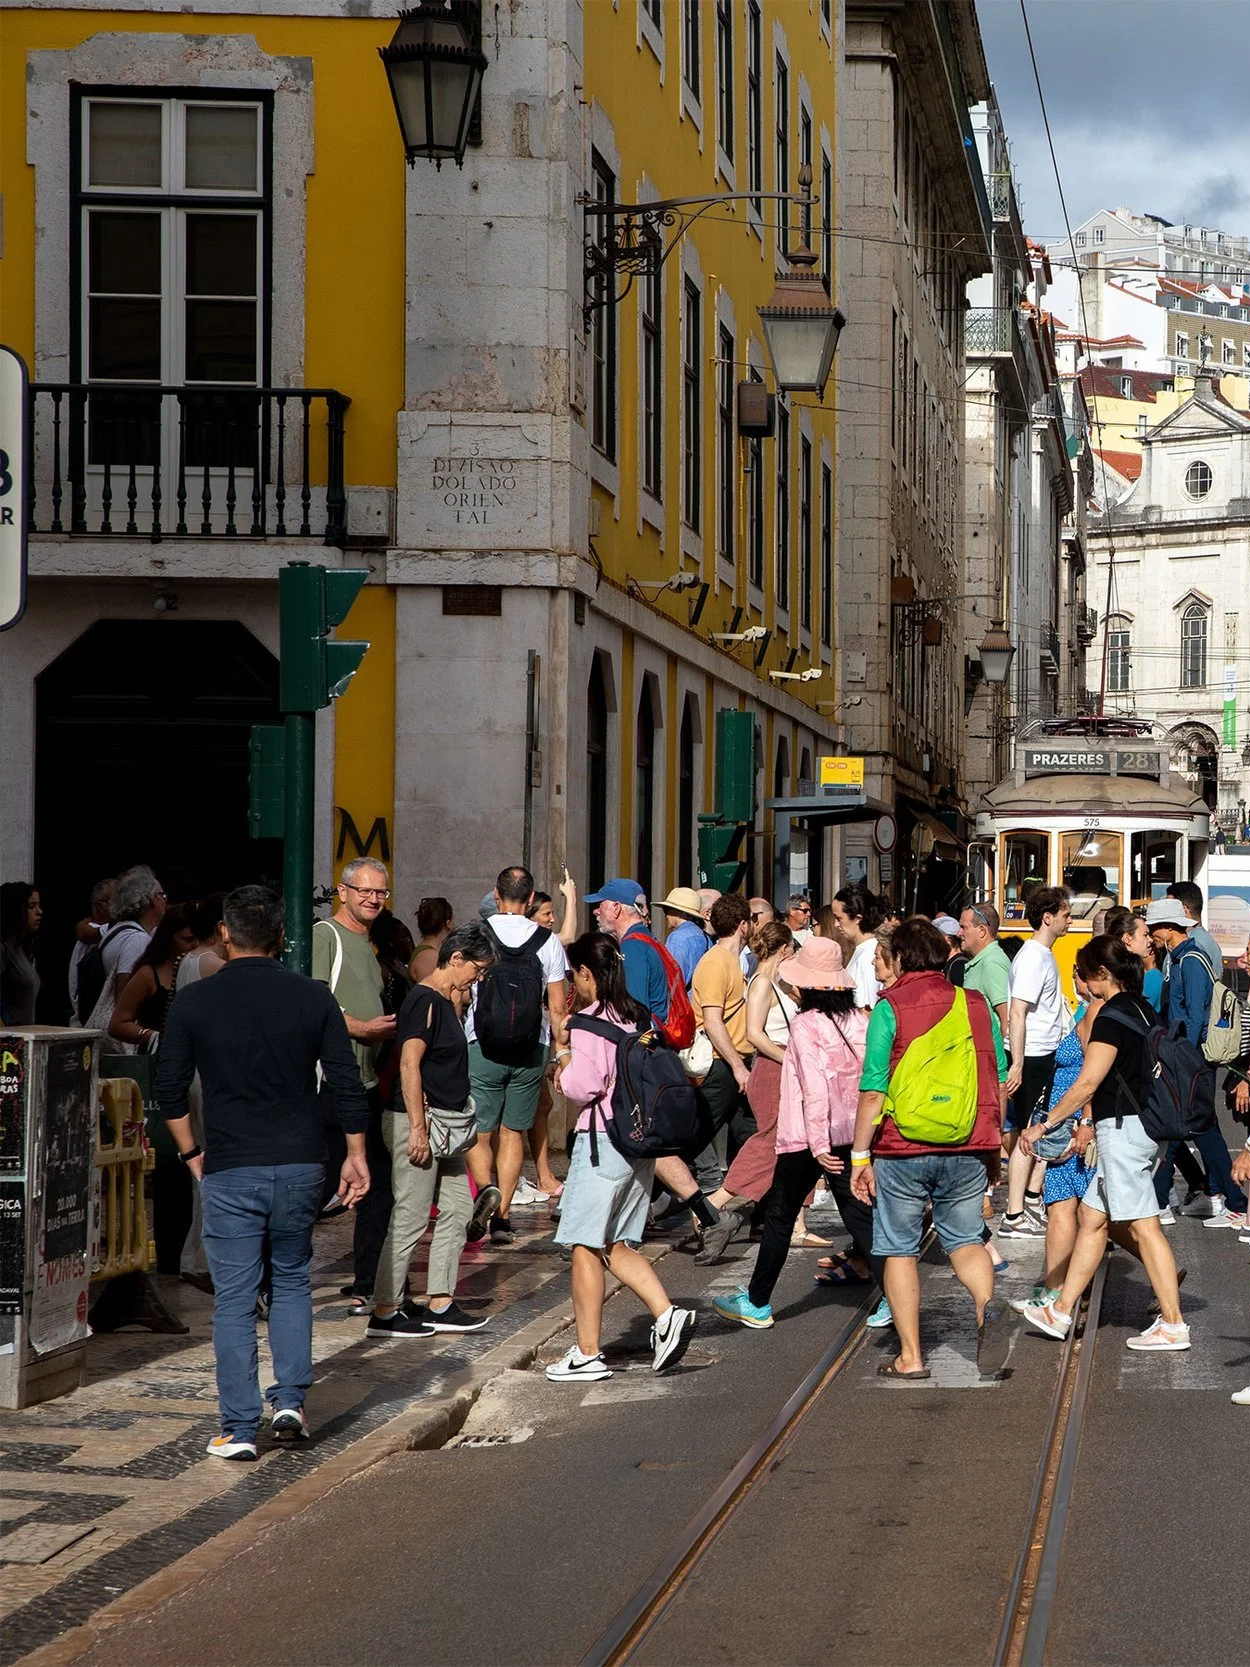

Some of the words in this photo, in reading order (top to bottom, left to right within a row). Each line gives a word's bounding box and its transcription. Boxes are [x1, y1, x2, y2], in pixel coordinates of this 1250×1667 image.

[1032, 754, 1105, 766] PRAZERES
[1122, 752, 1149, 769] 28
[1083, 818, 1100, 827] 575
